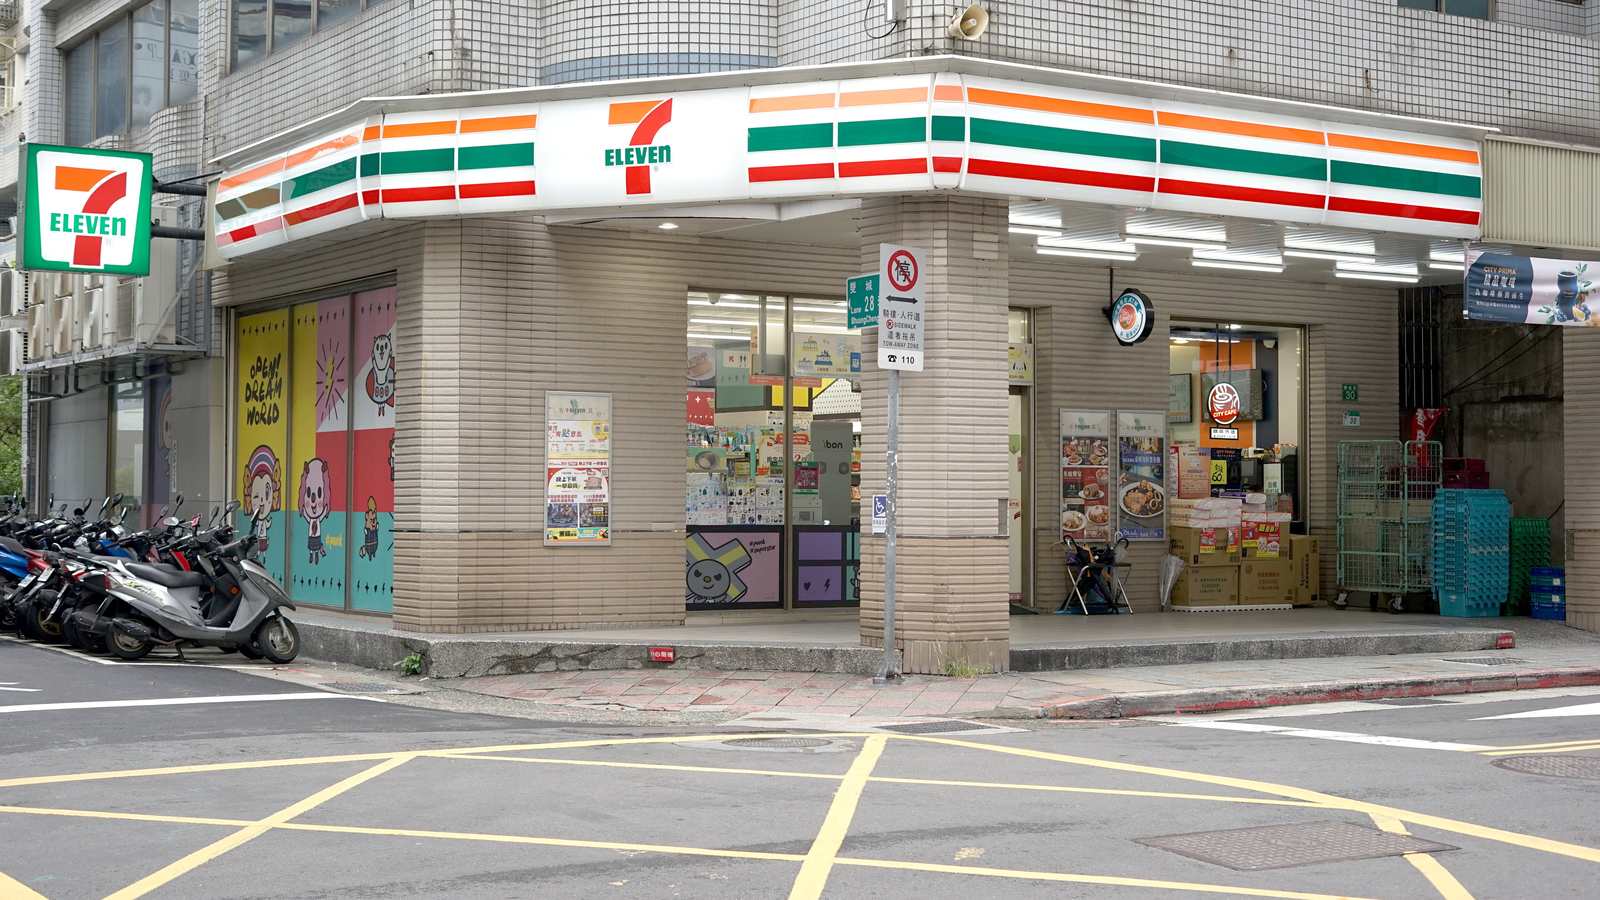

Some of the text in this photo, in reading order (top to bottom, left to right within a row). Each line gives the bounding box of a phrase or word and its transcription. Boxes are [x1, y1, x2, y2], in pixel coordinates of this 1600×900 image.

[608, 98, 673, 195] 7
[55, 165, 127, 267] 7
[894, 260, 912, 283] 停
[250, 352, 281, 379] OPEN!
[901, 356, 915, 365] 110
[245, 377, 282, 402] DREAM
[1345, 391, 1355, 400] 30
[247, 402, 280, 426] WORLD
